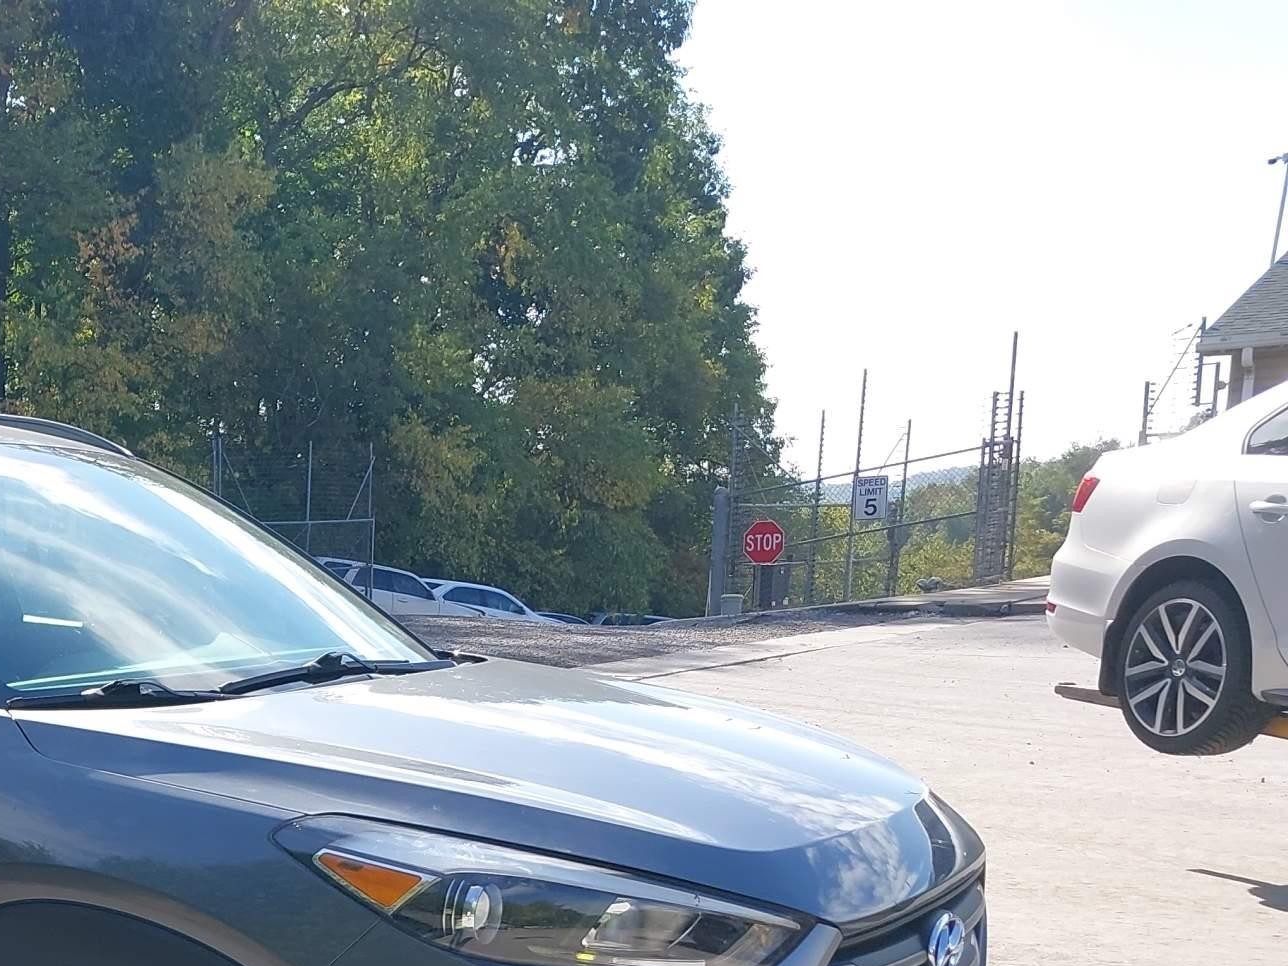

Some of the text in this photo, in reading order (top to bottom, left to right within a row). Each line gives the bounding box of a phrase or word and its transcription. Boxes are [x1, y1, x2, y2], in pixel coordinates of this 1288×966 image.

[857, 477, 886, 487] SPEED
[859, 487, 883, 496] LIMIT
[864, 498, 877, 516] 5
[746, 533, 781, 551] STOP
